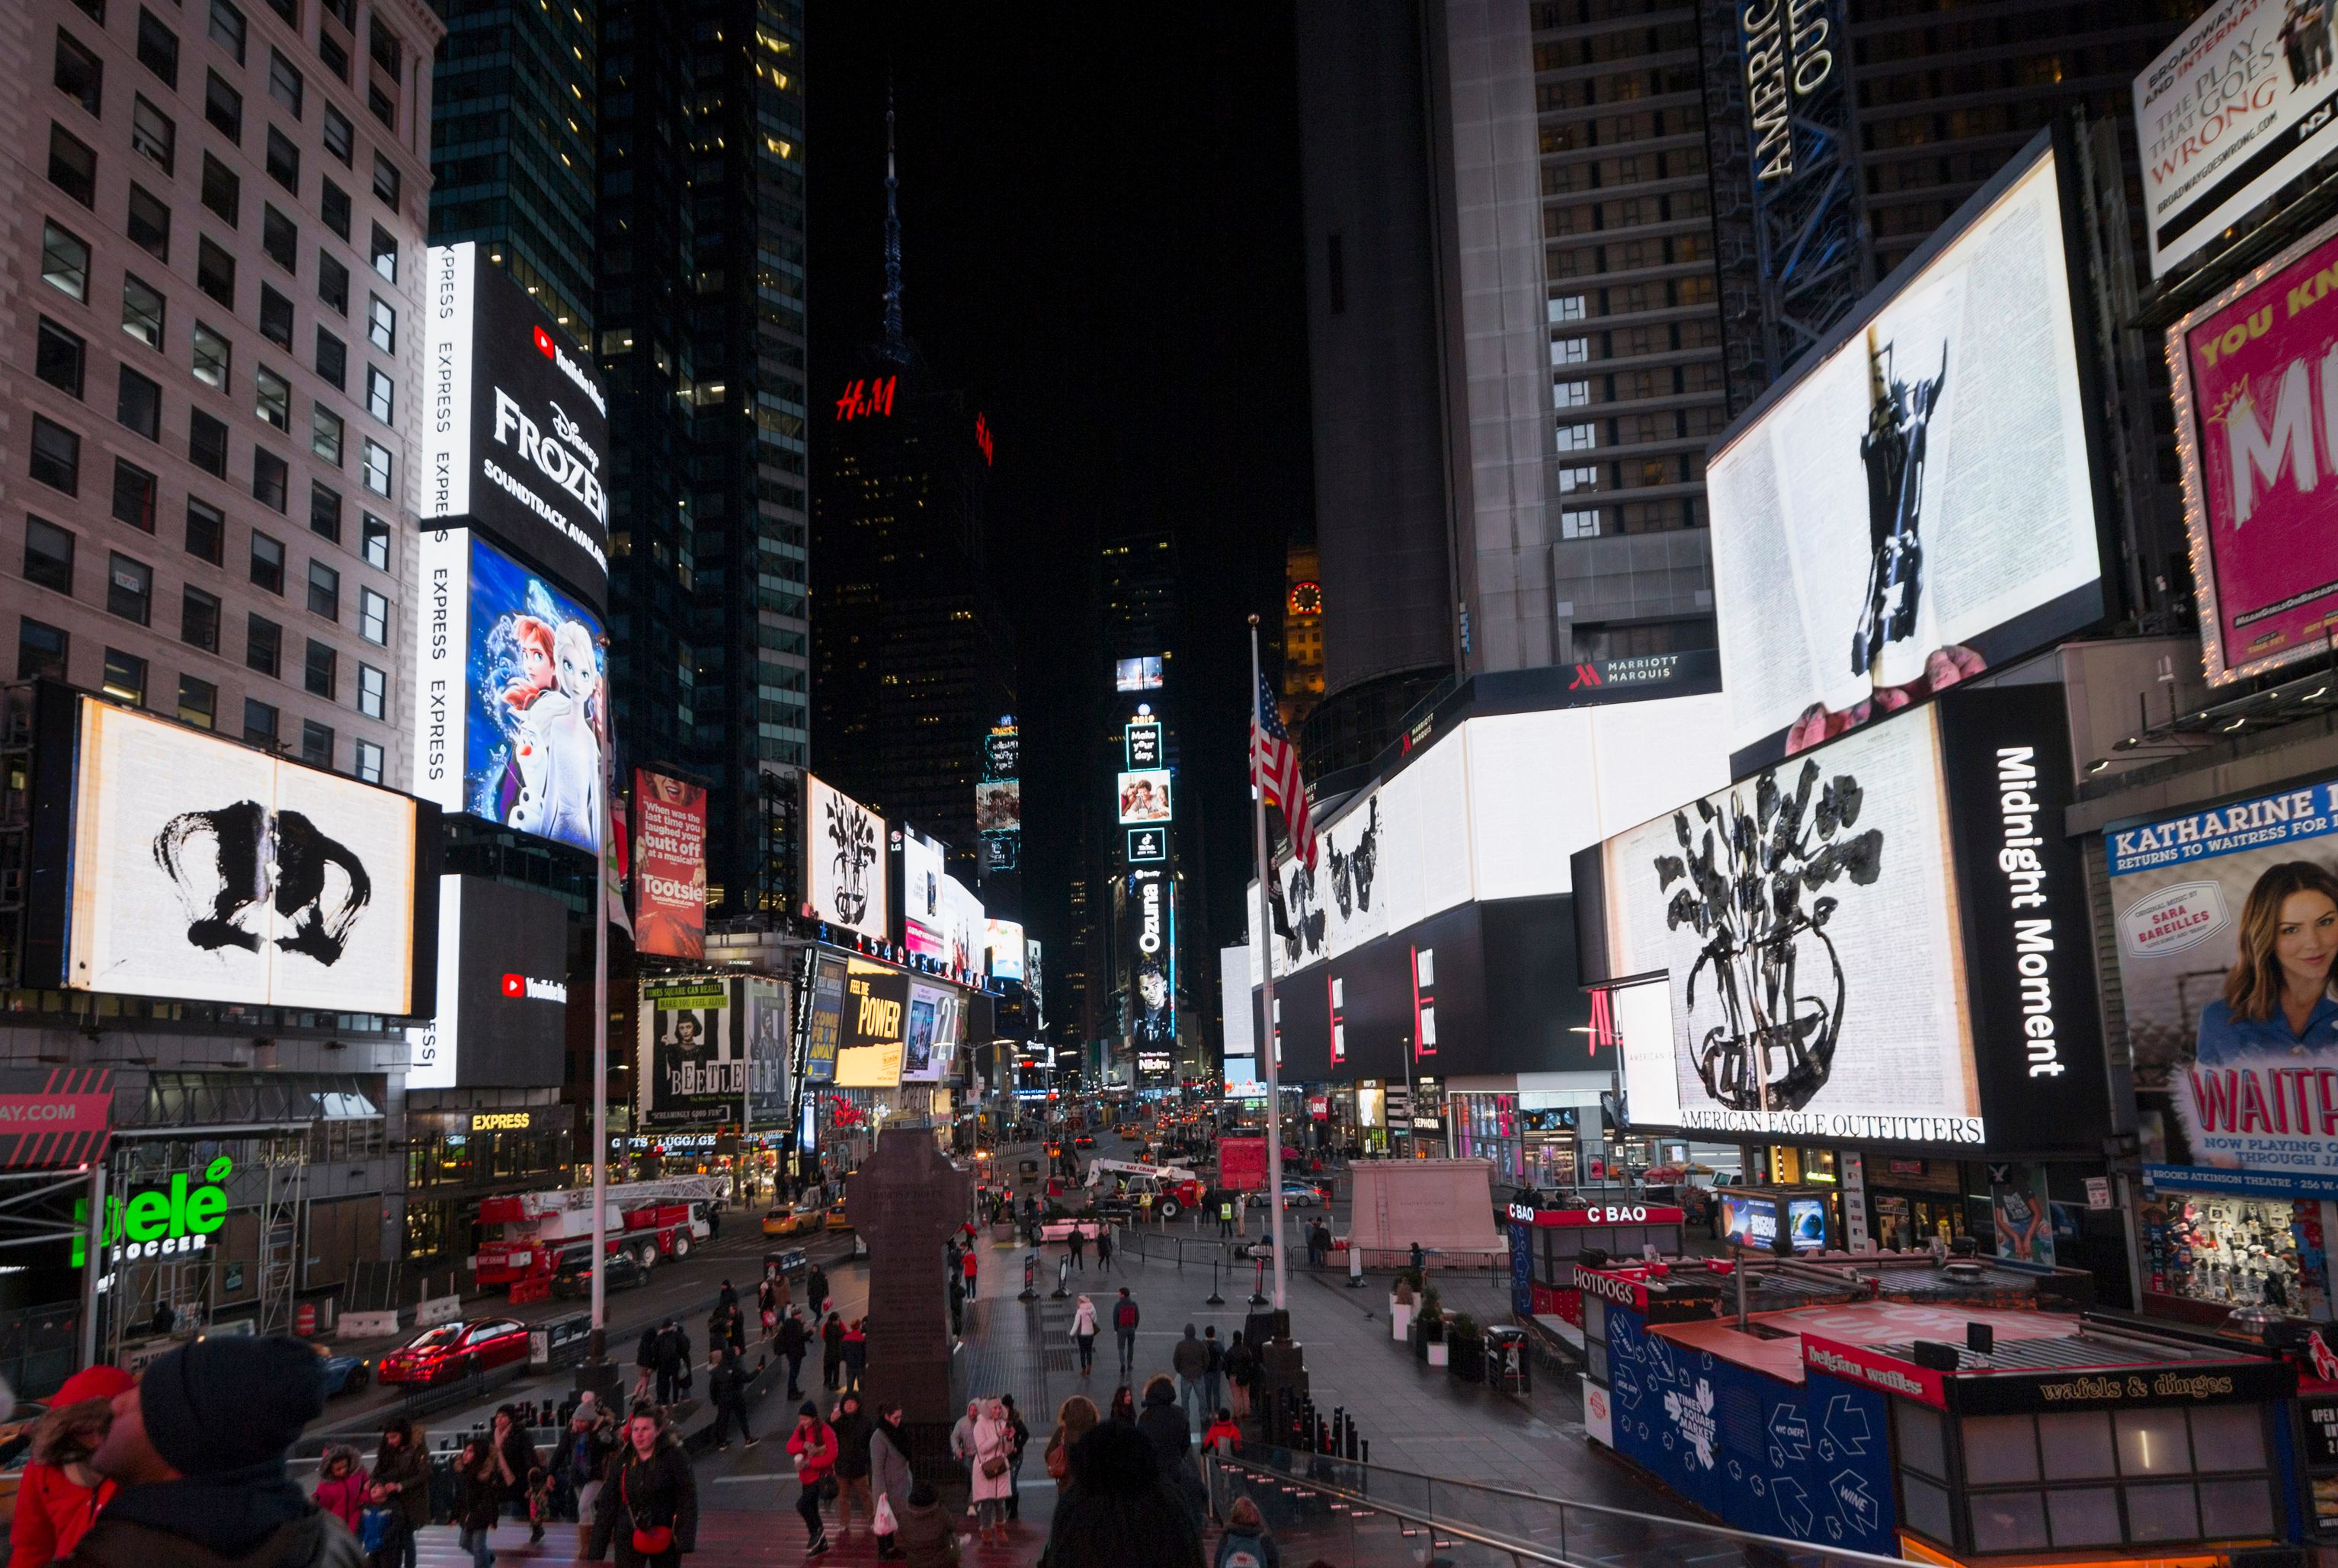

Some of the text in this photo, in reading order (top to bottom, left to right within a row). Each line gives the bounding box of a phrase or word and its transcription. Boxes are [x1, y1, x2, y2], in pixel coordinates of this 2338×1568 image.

[2157, 27, 2258, 133] THE PLAY
[2144, 77, 2176, 110] AND
[2148, 40, 2275, 159] THAT GOES
[2151, 76, 2279, 185] WRONG
[2200, 304, 2273, 369] YOU
[555, 344, 590, 396] YouTube
[437, 342, 452, 434] EXPRESS
[836, 375, 897, 421] H&M
[484, 459, 567, 534] SOUNDTRACK
[433, 568, 447, 661] EXPRESS
[1608, 655, 1678, 671] MARRIOTT
[1609, 667, 1670, 683] MARQUIS
[431, 680, 446, 781] EXPRESS
[1131, 730, 1156, 741] Make
[1411, 713, 1434, 735] MARRIOTT
[1412, 725, 1432, 745] MARQUIS
[1133, 741, 1155, 752] your
[1134, 750, 1154, 761] day.
[645, 810, 700, 834] last time you
[671, 809, 687, 820] was
[688, 812, 700, 823] the
[2115, 789, 2315, 858] KATHARINE
[645, 822, 700, 843] laughed your
[2117, 817, 2327, 871] RETURNS TO WAITRESS FOR
[645, 832, 700, 858] butt off
[648, 849, 656, 858] at
[642, 873, 703, 902] Tootsie
[2189, 890, 2198, 899] BY
[1139, 883, 1160, 953] Ozuna
[1997, 747, 2065, 1077] Midnight Moment
[2152, 904, 2187, 924] SARA
[2138, 910, 2210, 943] BAREILLES
[856, 933, 905, 965] 1540
[525, 977, 557, 1001] YouTube
[647, 984, 722, 997] TIMES SQUARE CAN REALLY
[850, 979, 870, 996] FEEL THE
[660, 998, 677, 1008] MAKE
[679, 998, 690, 1007] YOU
[692, 997, 706, 1006] FEEL
[813, 1011, 838, 1026] COME
[857, 995, 902, 1038] POWER
[935, 997, 959, 1060] 21
[809, 1043, 836, 1060] AWAY
[1139, 1058, 1171, 1070] Nibiru
[472, 1113, 530, 1131] EXPRESS
[1414, 1117, 1440, 1129] SEPHORA
[1680, 1110, 1981, 1143] AMERICAN EAGLE OUTFITTERS
[2204, 1137, 2322, 1153] NOW PLAYING
[2235, 1150, 2317, 1166] THROUGH
[2153, 1170, 2189, 1180] BROOKS
[2190, 1172, 2243, 1184] ATKINSON
[2244, 1176, 2292, 1188] THEATRE
[2300, 1179, 2320, 1189] 256
[71, 1156, 232, 1269] pelé
[1509, 1202, 1534, 1222] C BAO
[1587, 1206, 1647, 1222] C BAO
[112, 1234, 207, 1262] SOCCER
[1573, 1266, 1634, 1304] HOTDOGS
[1808, 1345, 1923, 1396] belgian waffles
[2041, 1372, 2233, 1401] wafels & dinges
[1677, 1392, 1702, 1413] TIMES
[1683, 1407, 1715, 1429] SQUARE
[2311, 1409, 2335, 1422] OPEN
[1680, 1419, 1715, 1442] MARKET
[1775, 1424, 1786, 1434] NYC
[2328, 1441, 2335, 1454] 2
[1840, 1484, 1869, 1512] WINE
